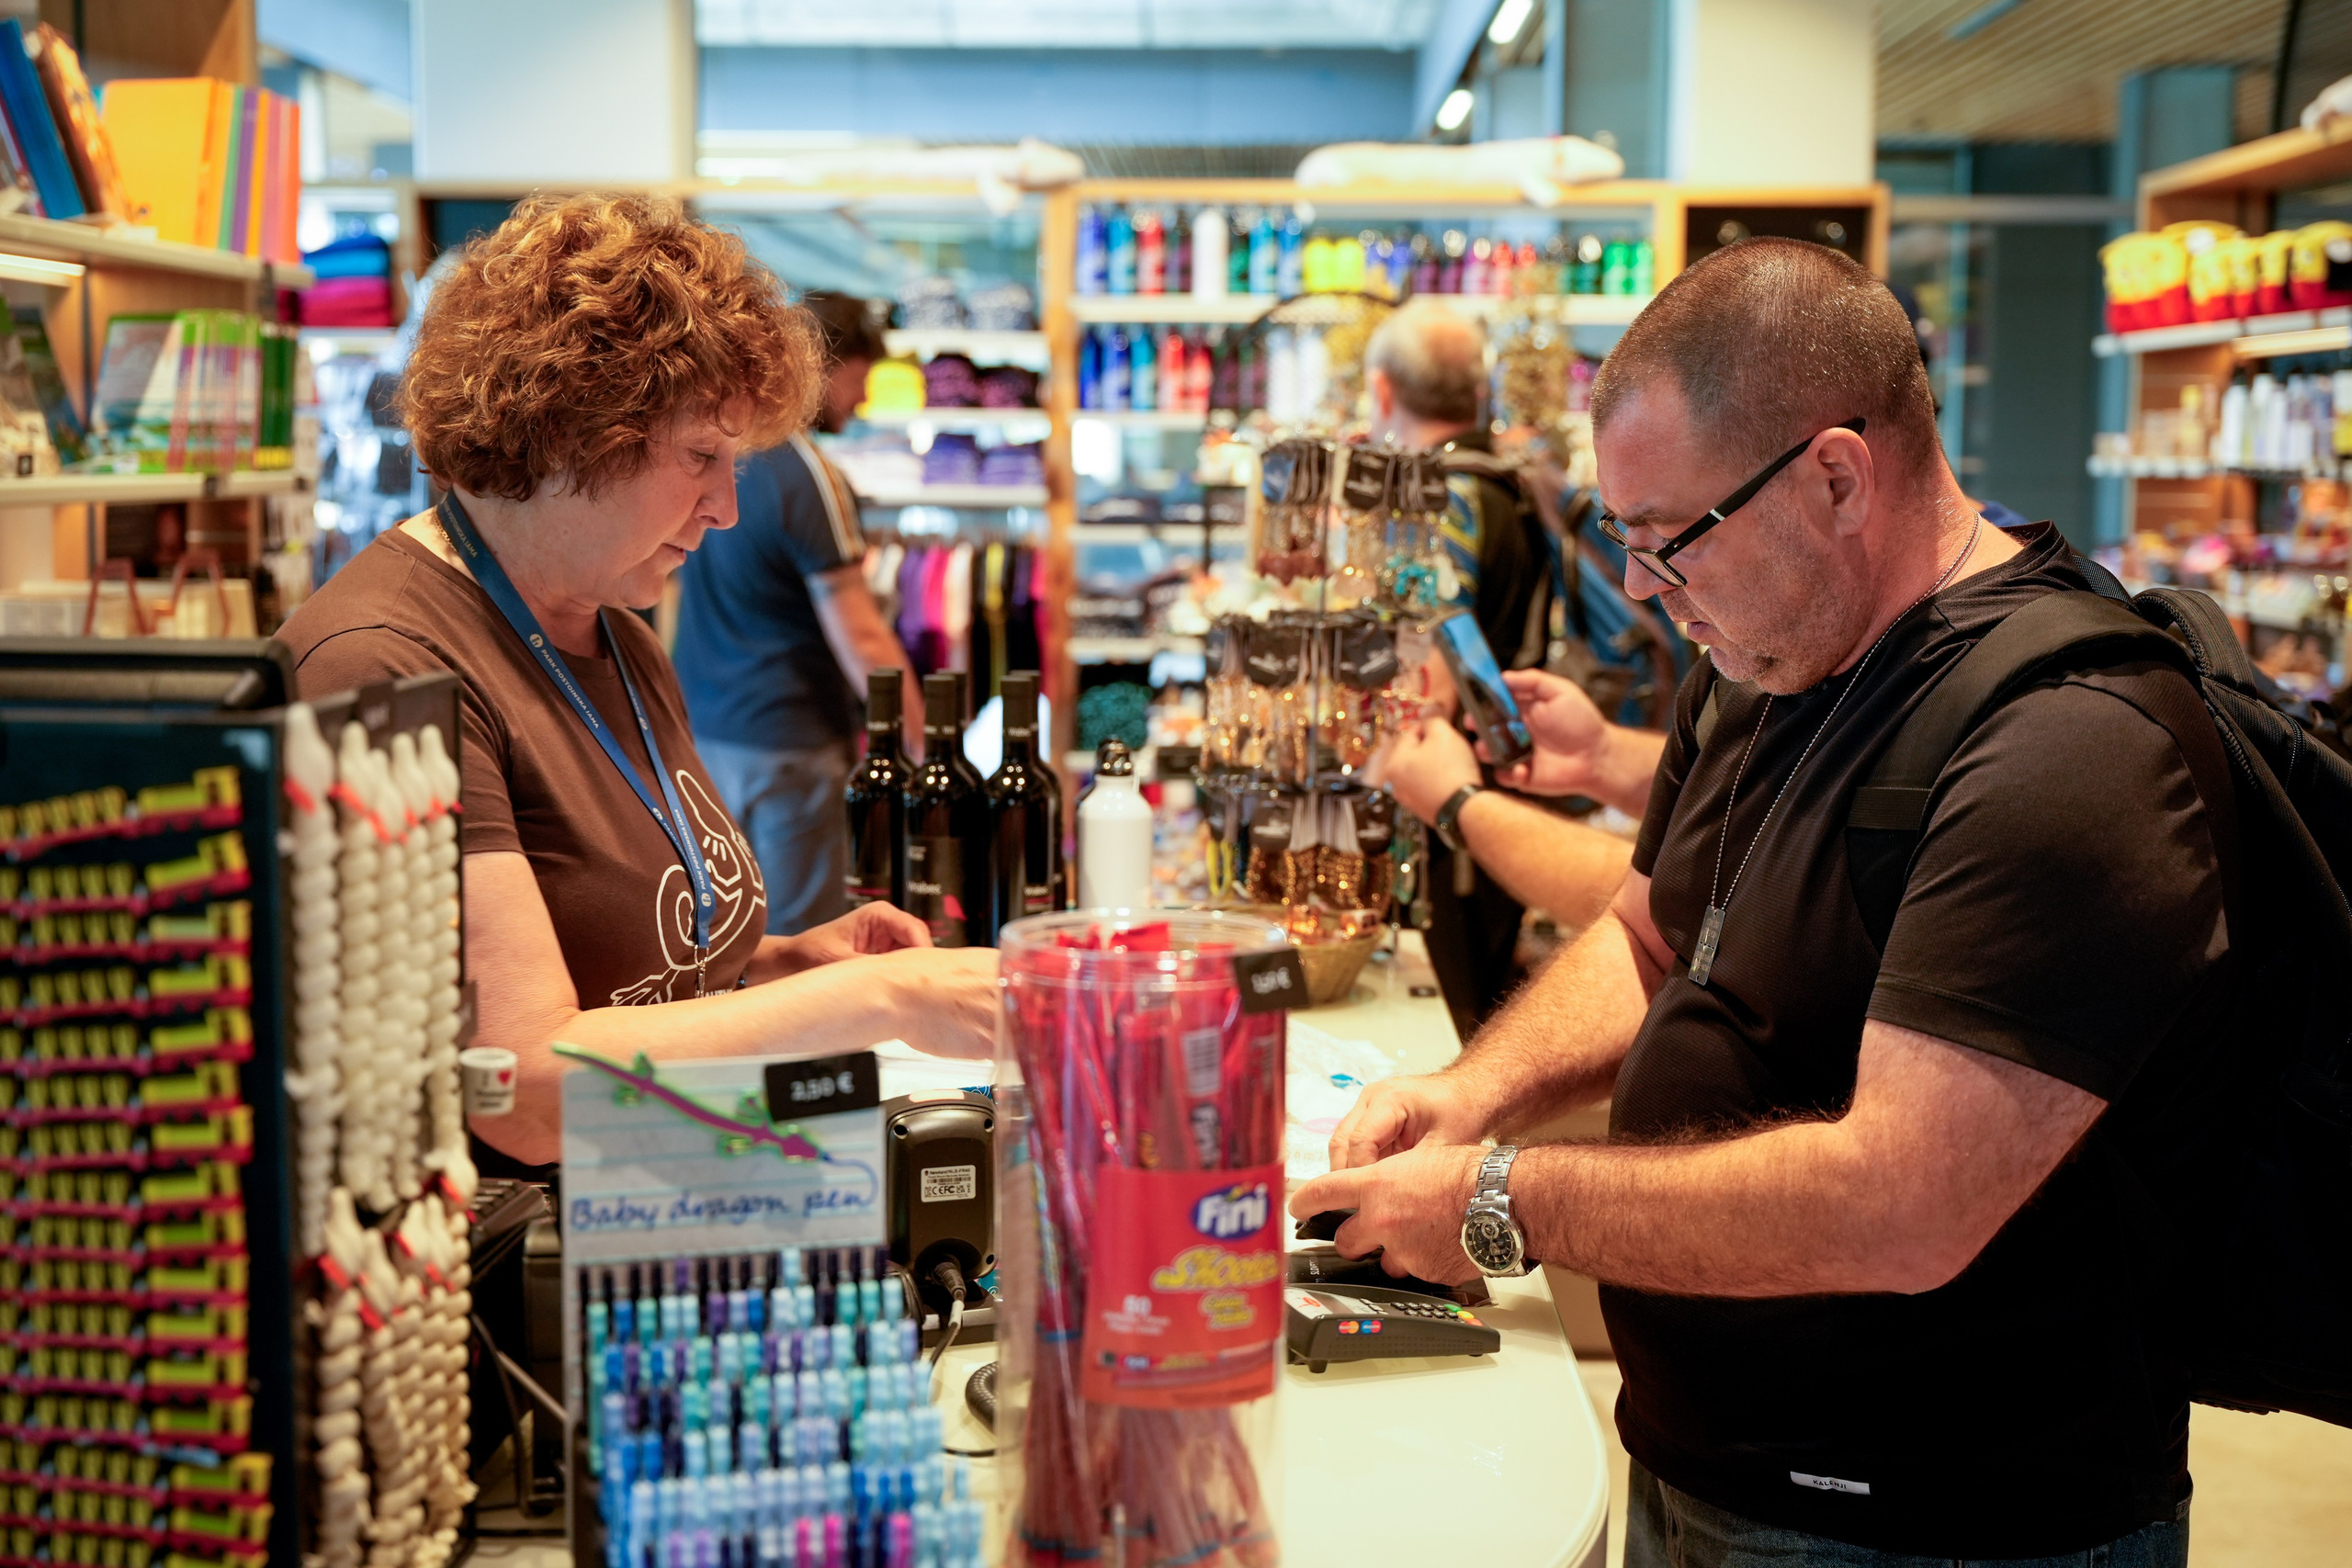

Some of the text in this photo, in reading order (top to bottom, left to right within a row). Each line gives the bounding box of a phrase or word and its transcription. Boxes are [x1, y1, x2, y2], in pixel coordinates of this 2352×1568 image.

[541, 649, 557, 669] PARK
[697, 870, 707, 890] PARK
[570, 1190, 868, 1232] Baby dragon pen
[1813, 1480, 1847, 1489] KALENJI
